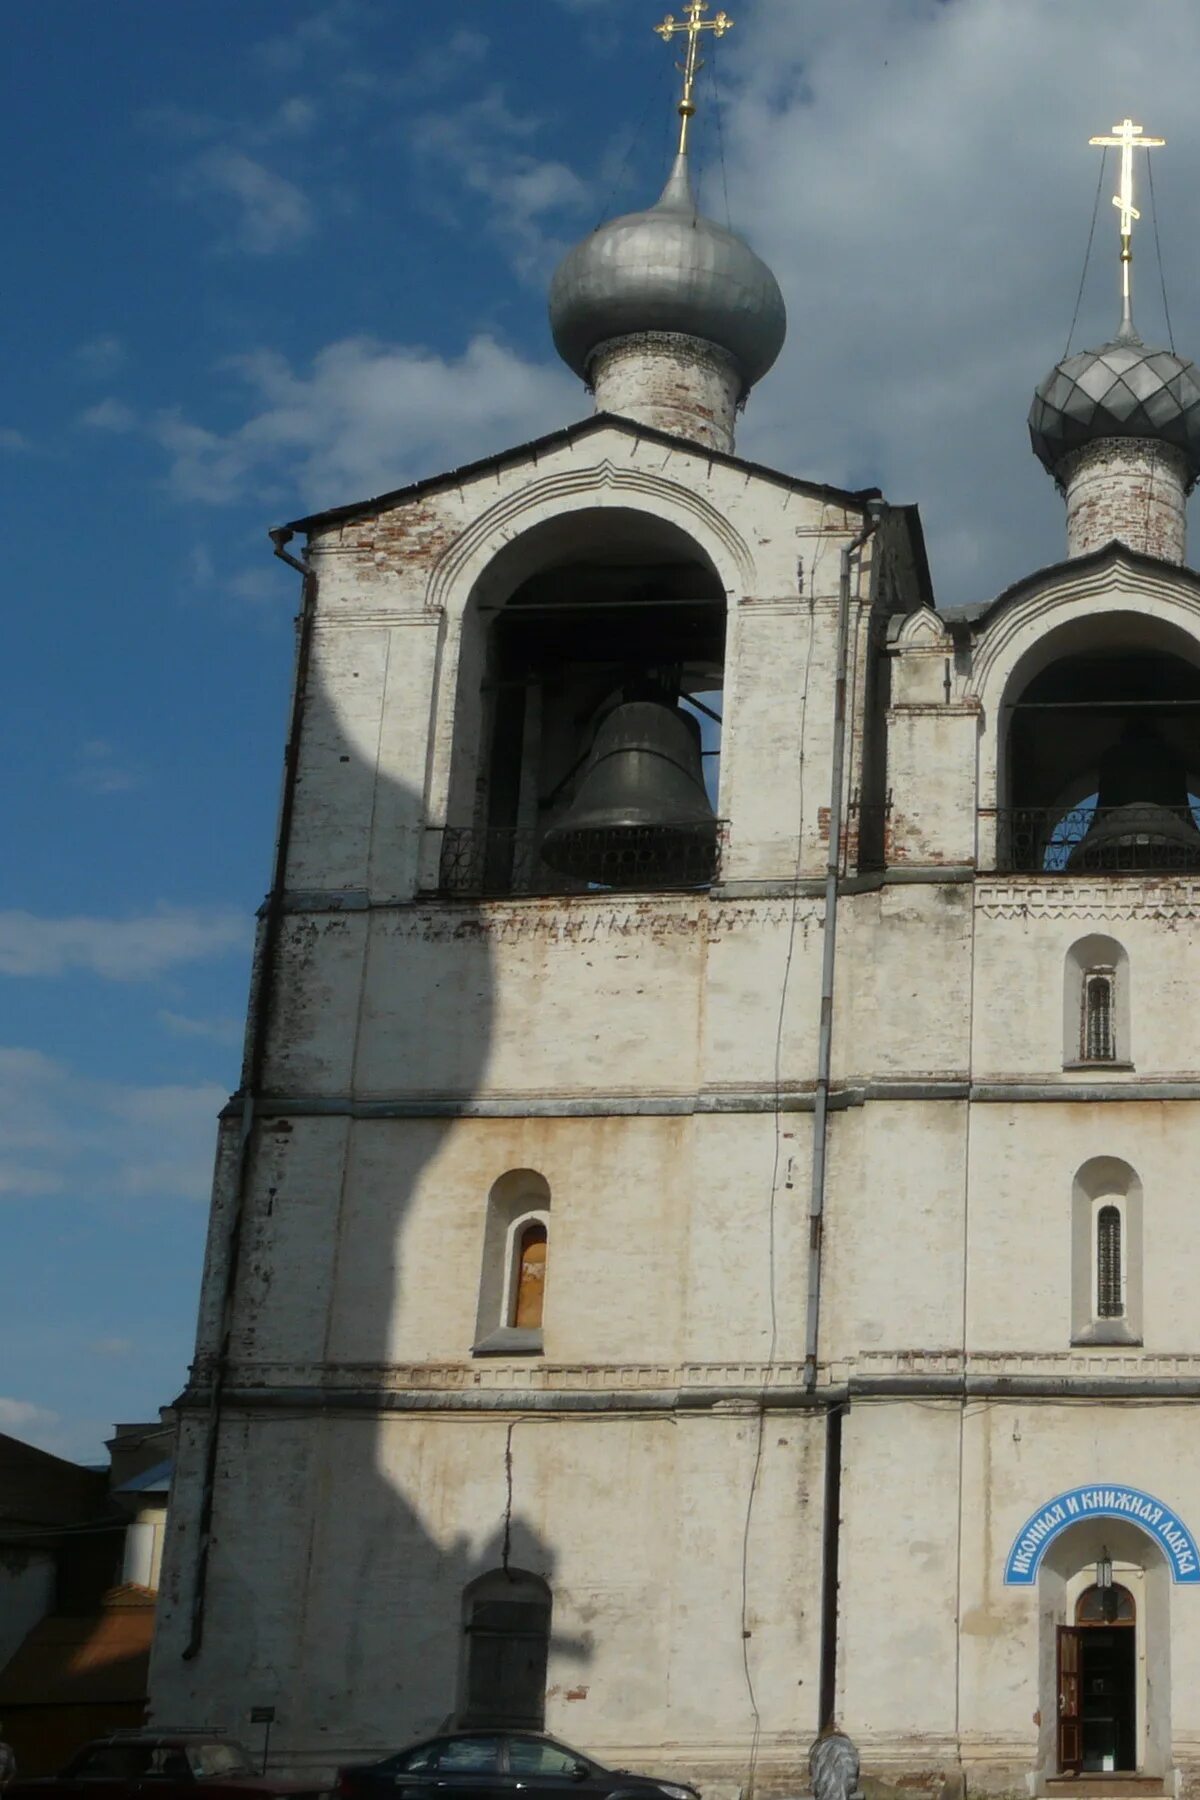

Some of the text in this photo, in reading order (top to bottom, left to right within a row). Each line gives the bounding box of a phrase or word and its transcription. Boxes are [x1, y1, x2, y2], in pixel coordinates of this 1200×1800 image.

[1013, 1491, 1196, 1574] ИКОННАЯ И КНИЖНАЯ ЛАВКА
